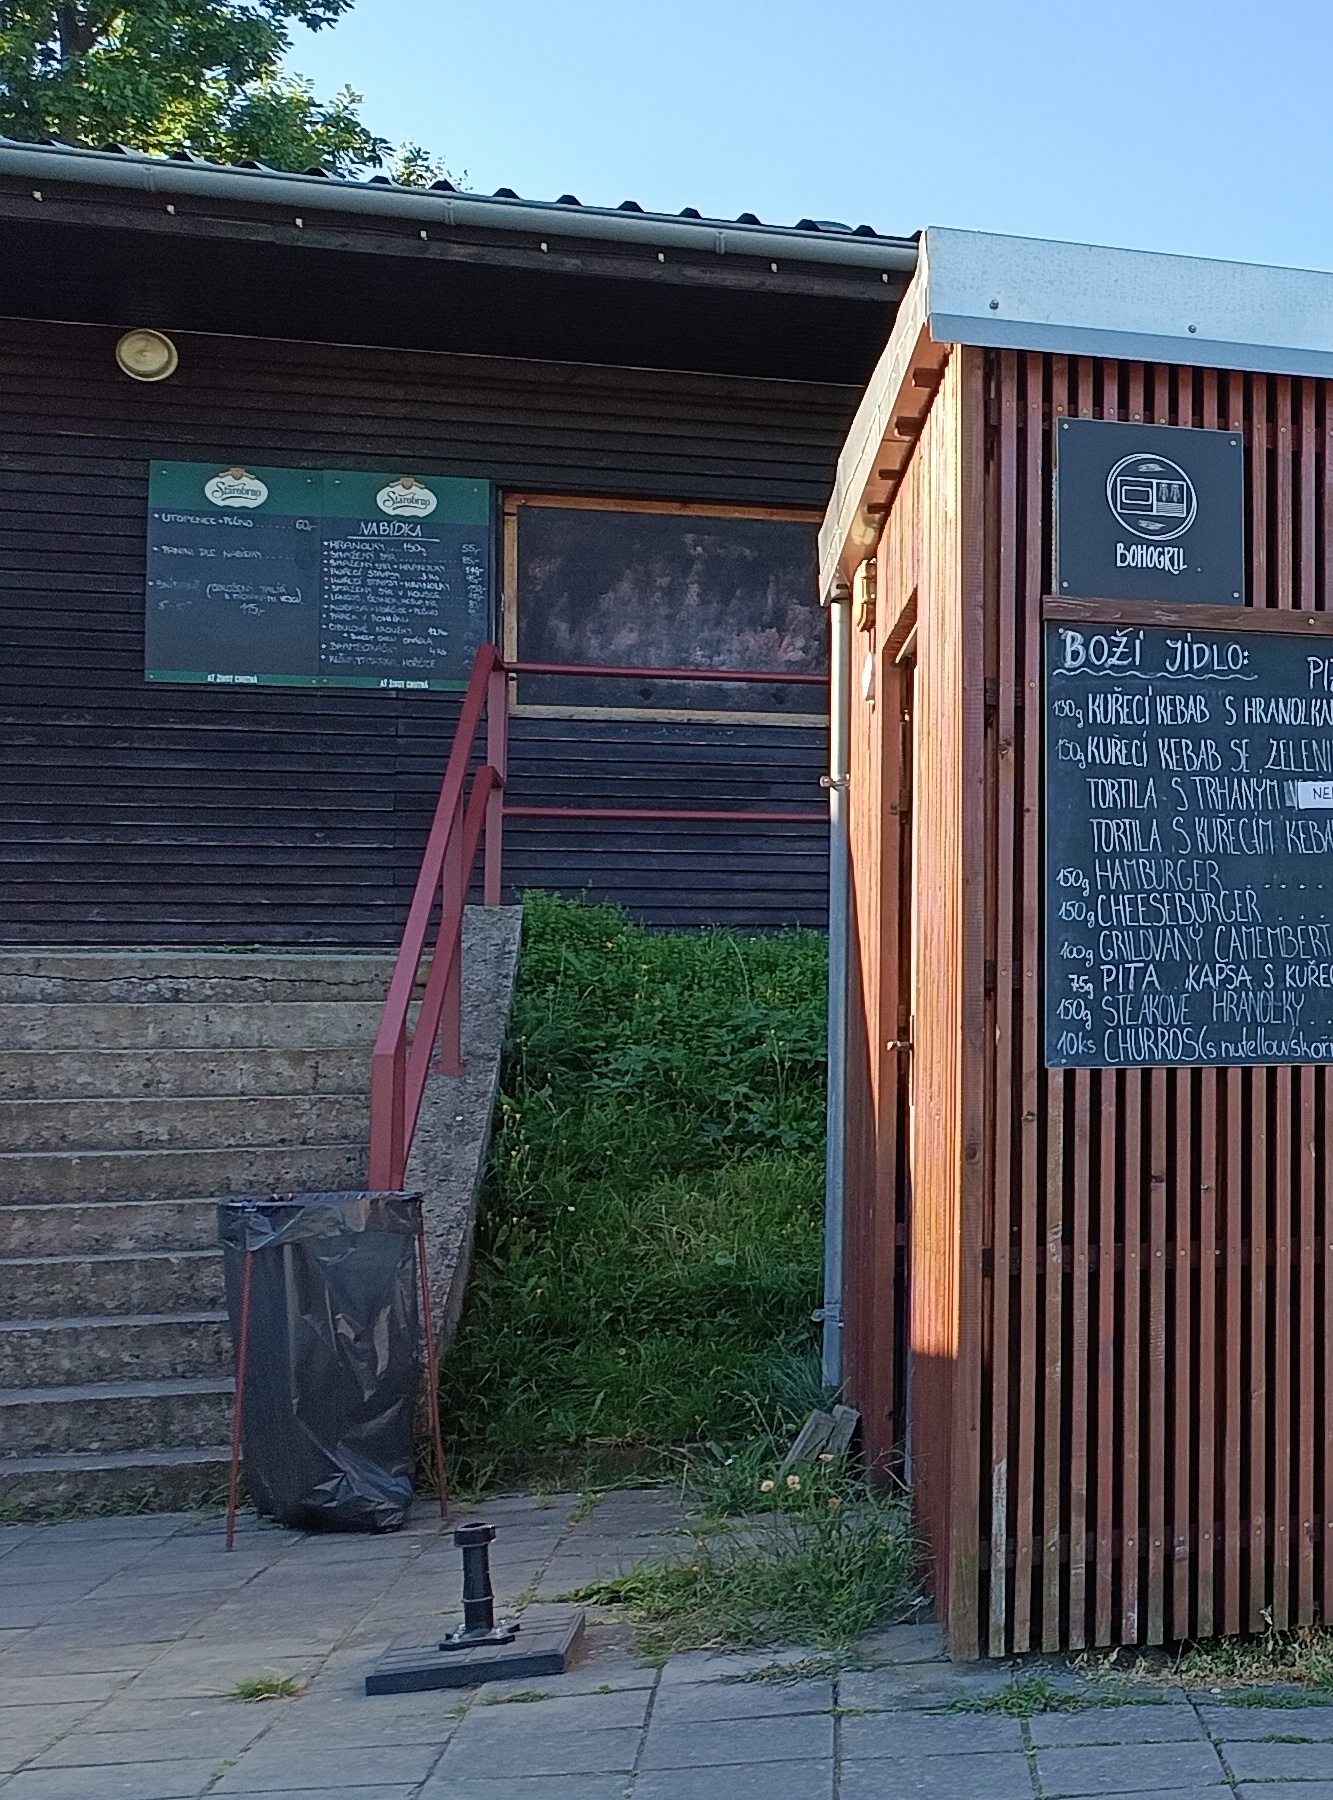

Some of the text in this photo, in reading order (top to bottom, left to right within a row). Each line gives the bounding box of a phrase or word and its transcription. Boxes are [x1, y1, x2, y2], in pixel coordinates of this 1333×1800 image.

[211, 481, 262, 500] Starobrno
[382, 490, 431, 509] Starobrno
[360, 520, 422, 537] NABÍDKA
[1116, 542, 1187, 574] BOHOGRIL
[1062, 628, 1250, 671] BOŽÍ JÍDLO:
[1087, 685, 1151, 726] KUŘECÍ
[1156, 693, 1210, 726] KEBAB
[1225, 696, 1237, 726] S
[1087, 731, 1149, 768] KUŘECÍ
[1158, 738, 1222, 773] KEBAB
[1230, 738, 1251, 773] SE
[1086, 777, 1158, 810] TORTILA
[1172, 777, 1188, 811] S
[1089, 818, 1162, 853] TORTILA
[1173, 816, 1191, 854] S
[1195, 812, 1275, 855] KUŘECÍM
[1055, 867, 1090, 897] 150g
[1095, 858, 1224, 892] HAMBURGER
[1058, 900, 1095, 929] 150g
[1096, 889, 1262, 927] CHEESEBURGER
[1059, 941, 1094, 968] 100g
[1099, 921, 1204, 962] GRILOVANÝ
[1214, 923, 1332, 963] CAMEMBERT
[1067, 974, 1094, 999] 75g
[1100, 962, 1161, 992] PITA
[1187, 962, 1252, 992] KAPSA
[1263, 963, 1276, 989] S
[1056, 997, 1091, 1030] 150g
[1212, 989, 1305, 1027] HRANOLKY
[1056, 1031, 1097, 1055] 10ks
